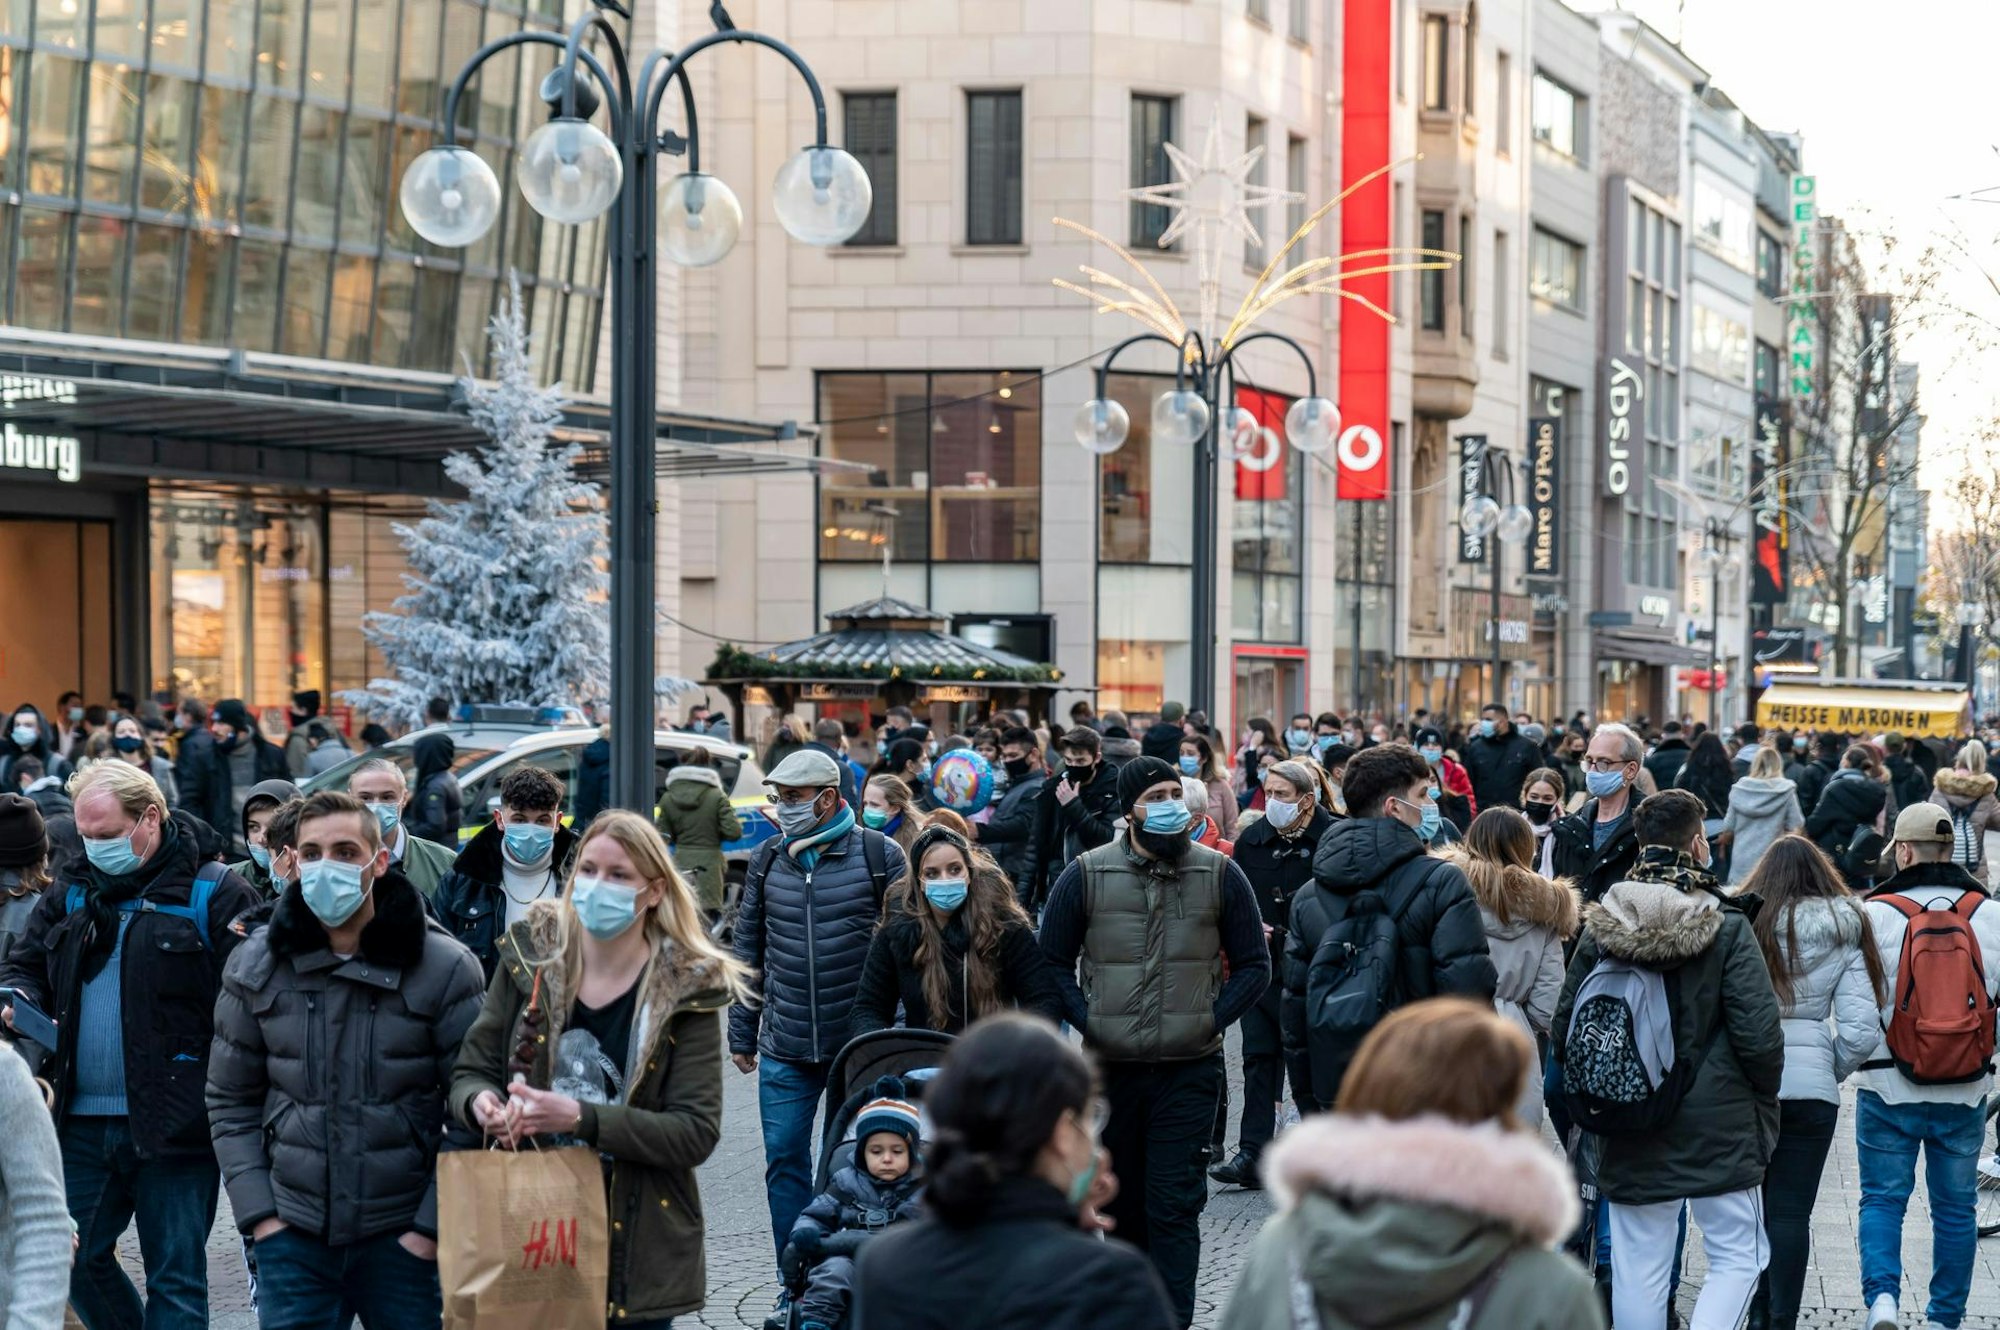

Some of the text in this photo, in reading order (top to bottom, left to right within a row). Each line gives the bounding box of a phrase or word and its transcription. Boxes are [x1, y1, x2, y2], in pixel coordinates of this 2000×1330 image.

[1608, 357, 1643, 495] orsay
[1534, 423, 1555, 503] O'Polo
[1533, 507, 1553, 570] Marc
[1769, 705, 1930, 729] HEISSE MARONEN
